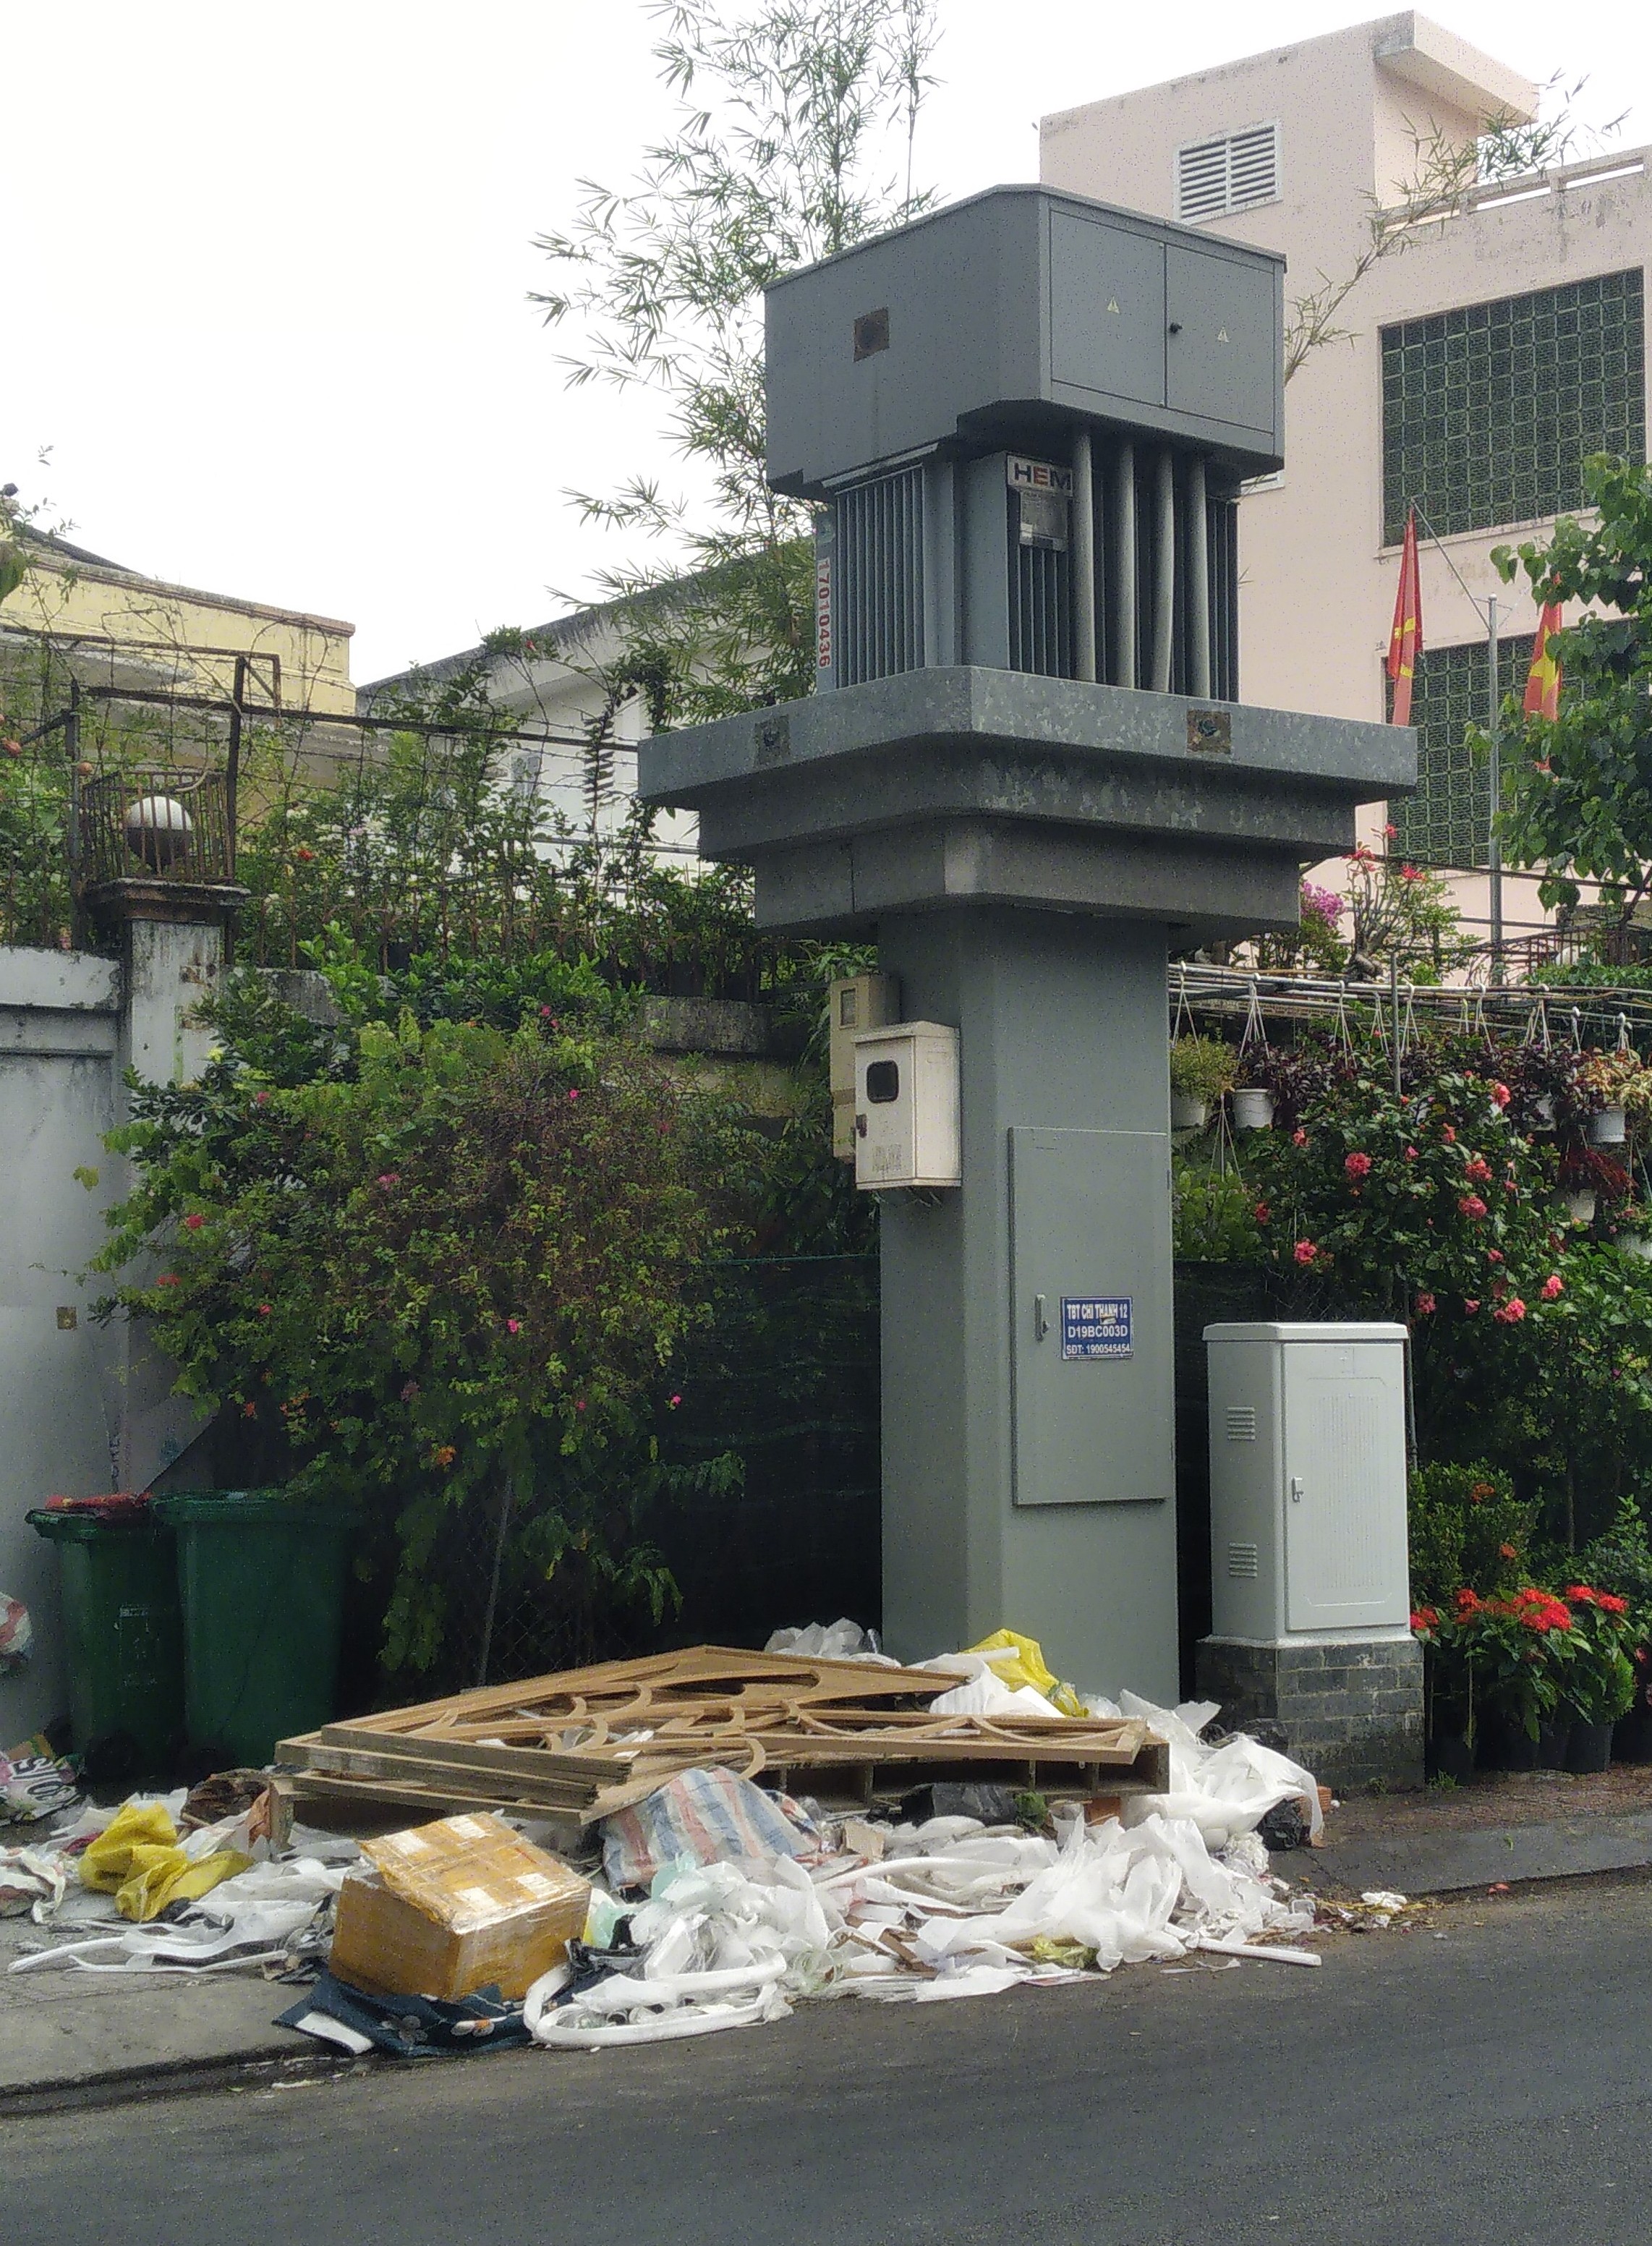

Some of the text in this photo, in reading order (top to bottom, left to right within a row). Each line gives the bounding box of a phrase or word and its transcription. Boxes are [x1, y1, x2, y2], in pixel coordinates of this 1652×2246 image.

[1014, 462, 1071, 490] HEM
[819, 560, 831, 668] 17010436
[1067, 1304, 1080, 1320] TBT
[1120, 1303, 1128, 1318] 12
[1068, 1325, 1128, 1338] D19BC003D
[1086, 1343, 1131, 1354] 1900545454
